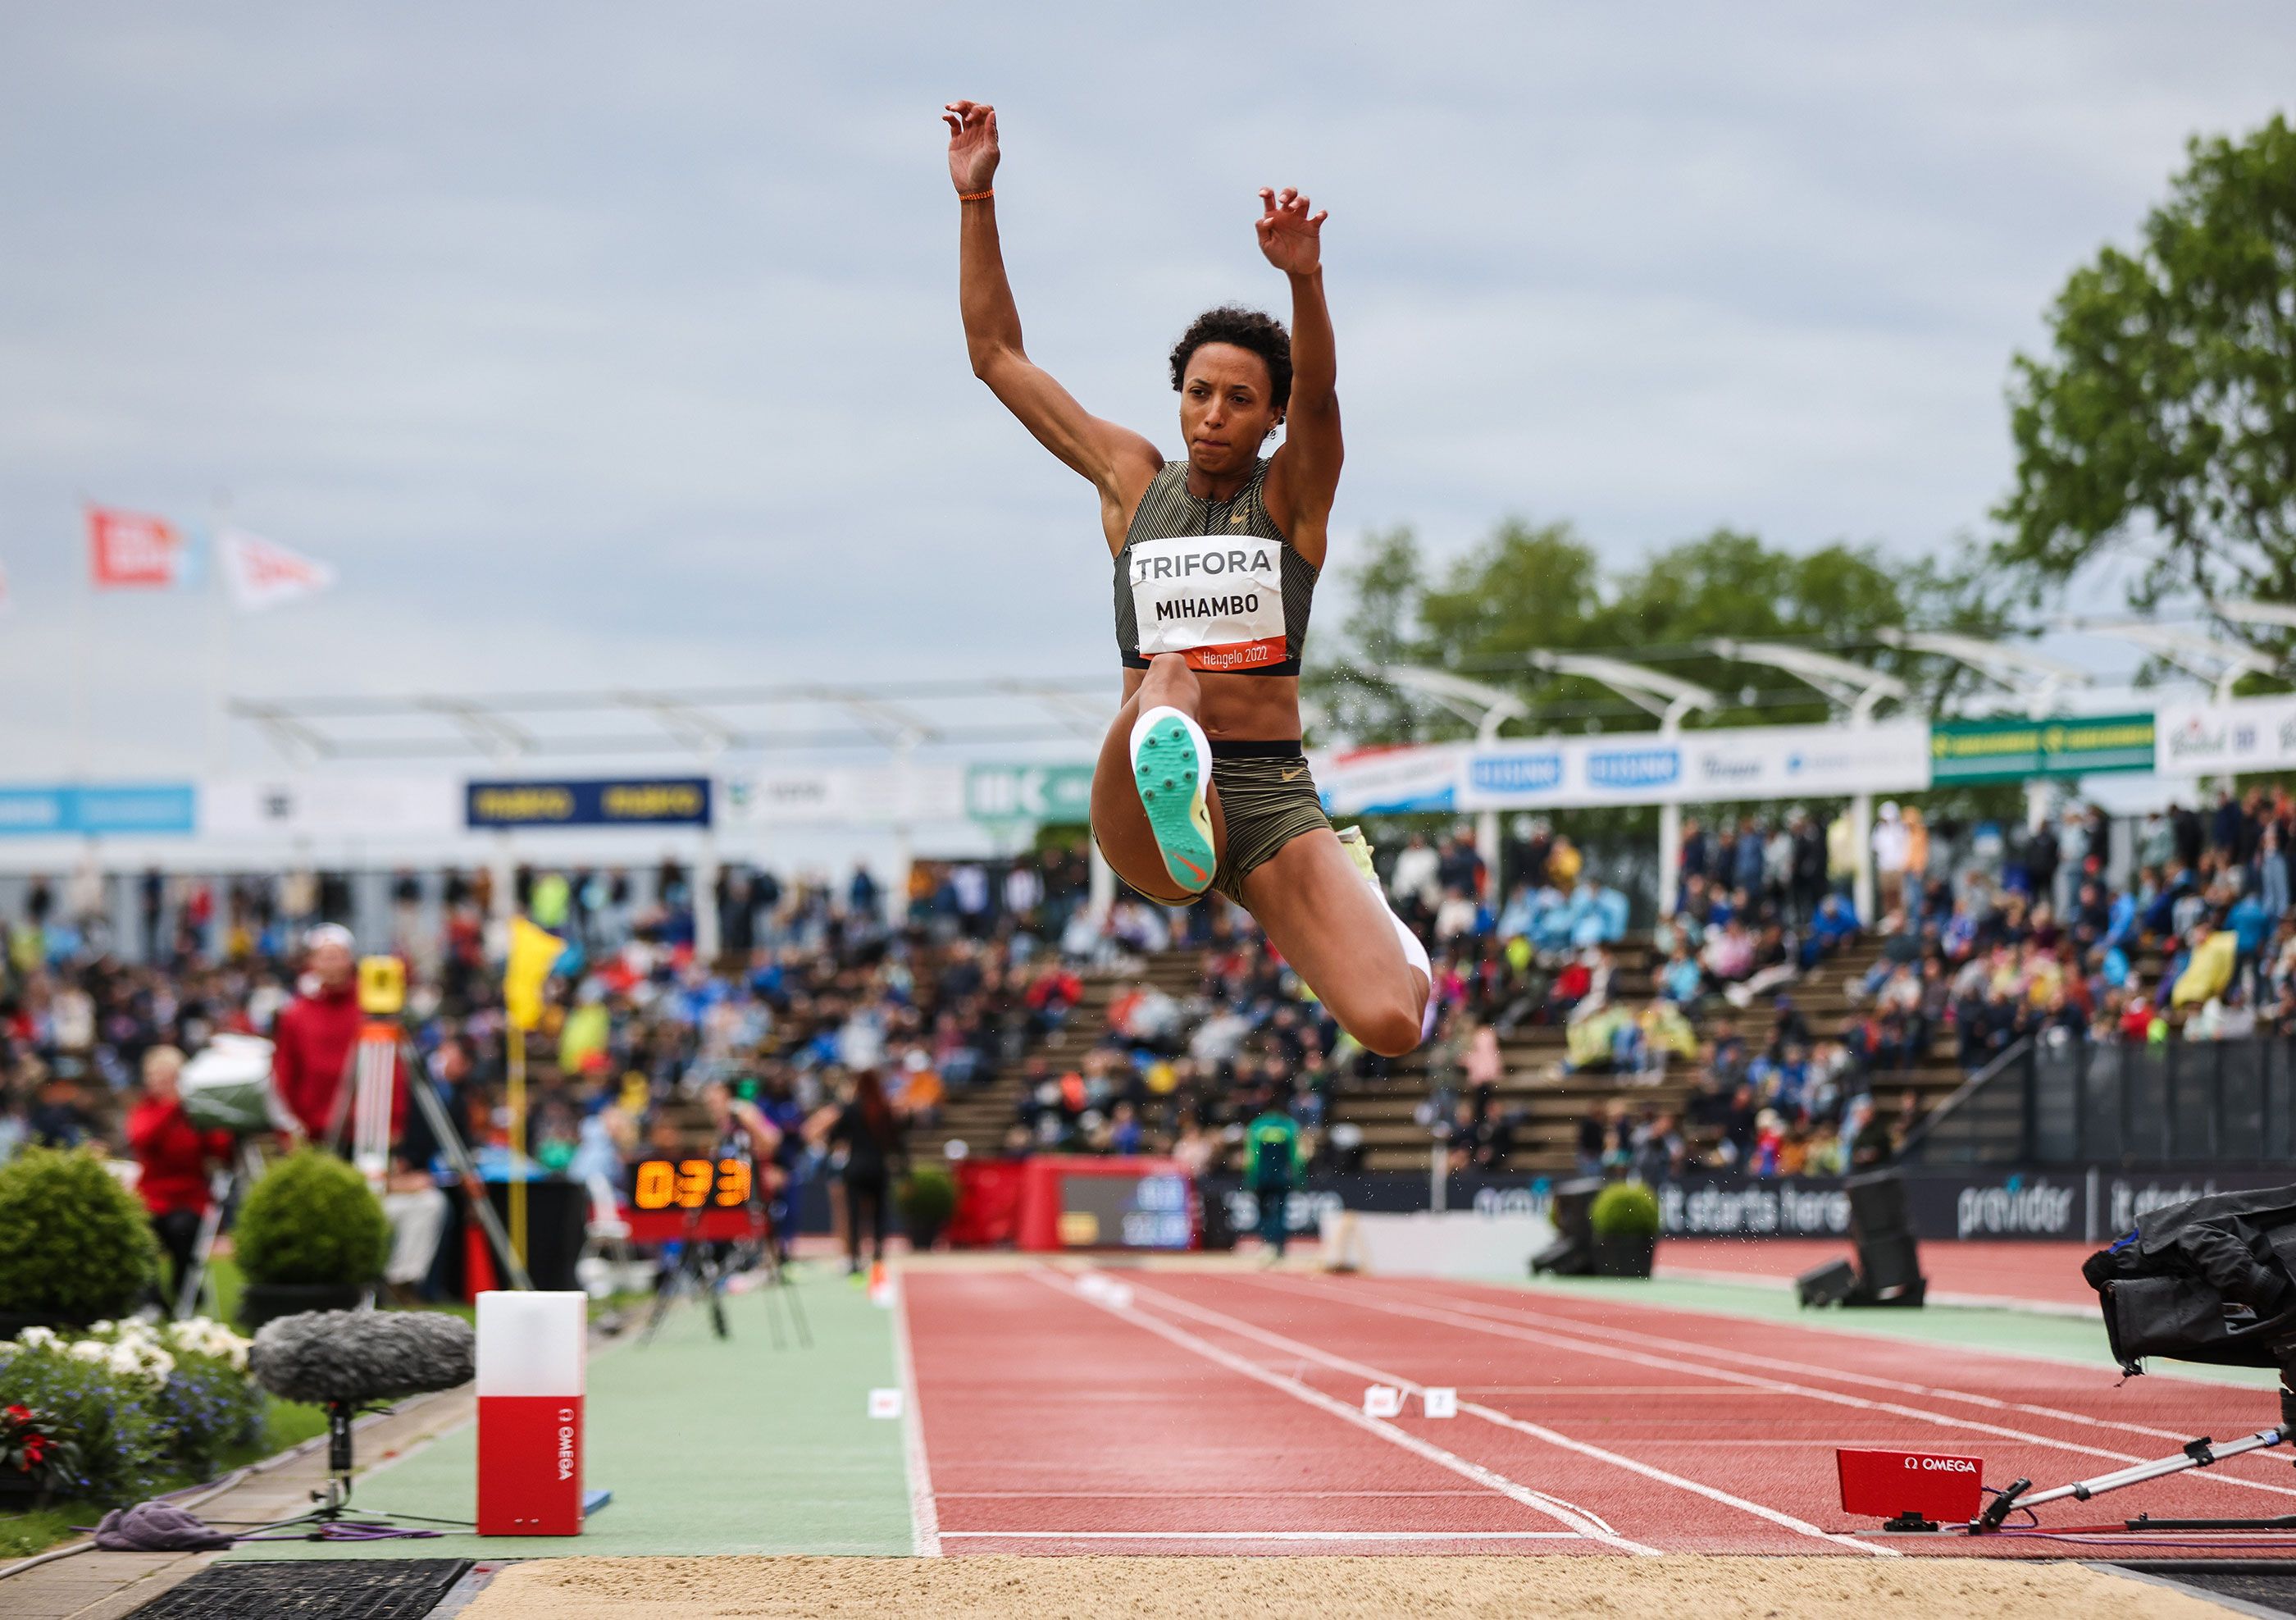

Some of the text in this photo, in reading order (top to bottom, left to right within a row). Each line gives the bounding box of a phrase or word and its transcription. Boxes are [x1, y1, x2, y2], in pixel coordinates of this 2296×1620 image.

[1137, 550, 1271, 580] TRIFORA
[1155, 594, 1259, 621] MIHAMBO
[1203, 646, 1268, 669] Hengelo 2022
[1685, 1184, 1779, 1232] starts
[1780, 1180, 1852, 1232] here
[1958, 1174, 2075, 1240] provider
[558, 1426, 574, 1481] OMEGA
[1922, 1458, 1977, 1473] OMEGA
